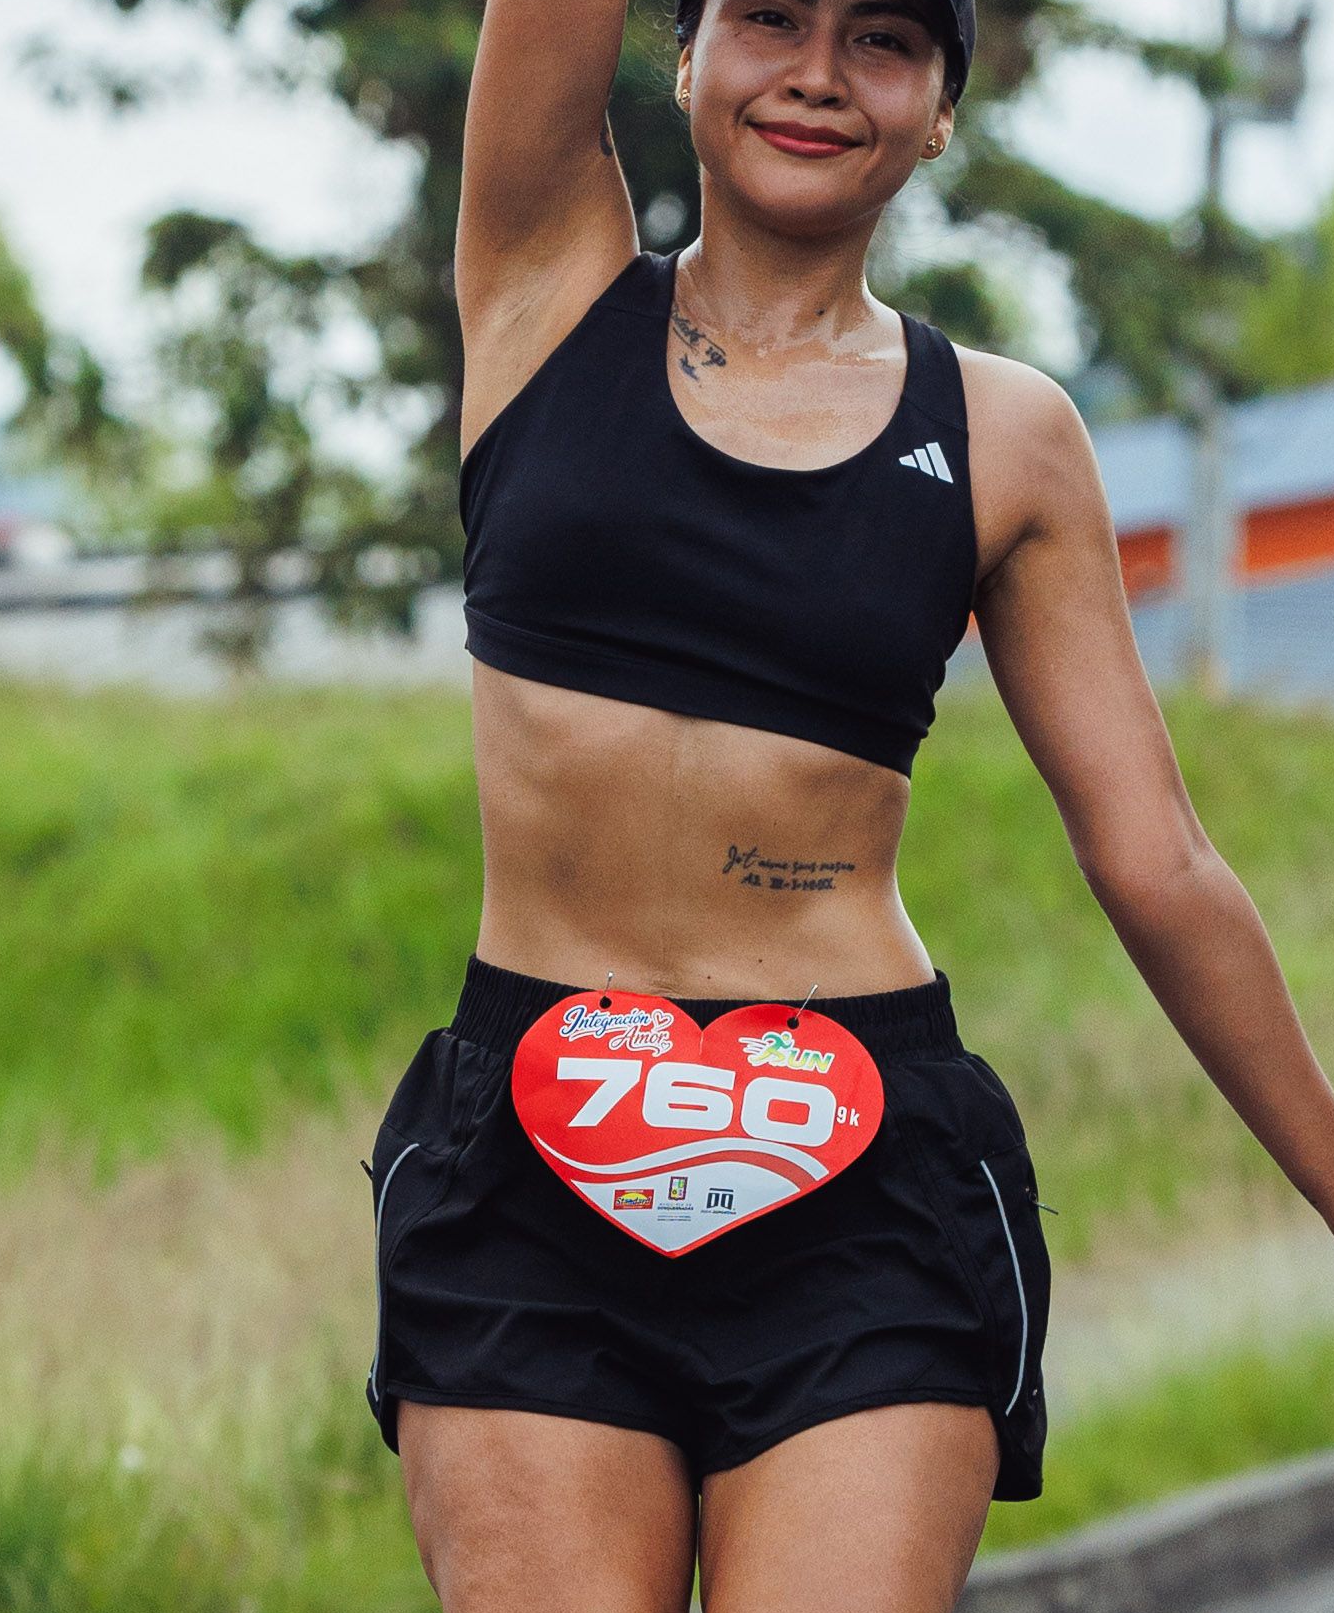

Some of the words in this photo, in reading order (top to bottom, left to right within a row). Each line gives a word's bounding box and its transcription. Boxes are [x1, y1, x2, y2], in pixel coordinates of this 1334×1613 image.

[560, 1006, 650, 1036] Integración
[610, 1026, 668, 1054] Amor
[556, 1057, 837, 1148] 760
